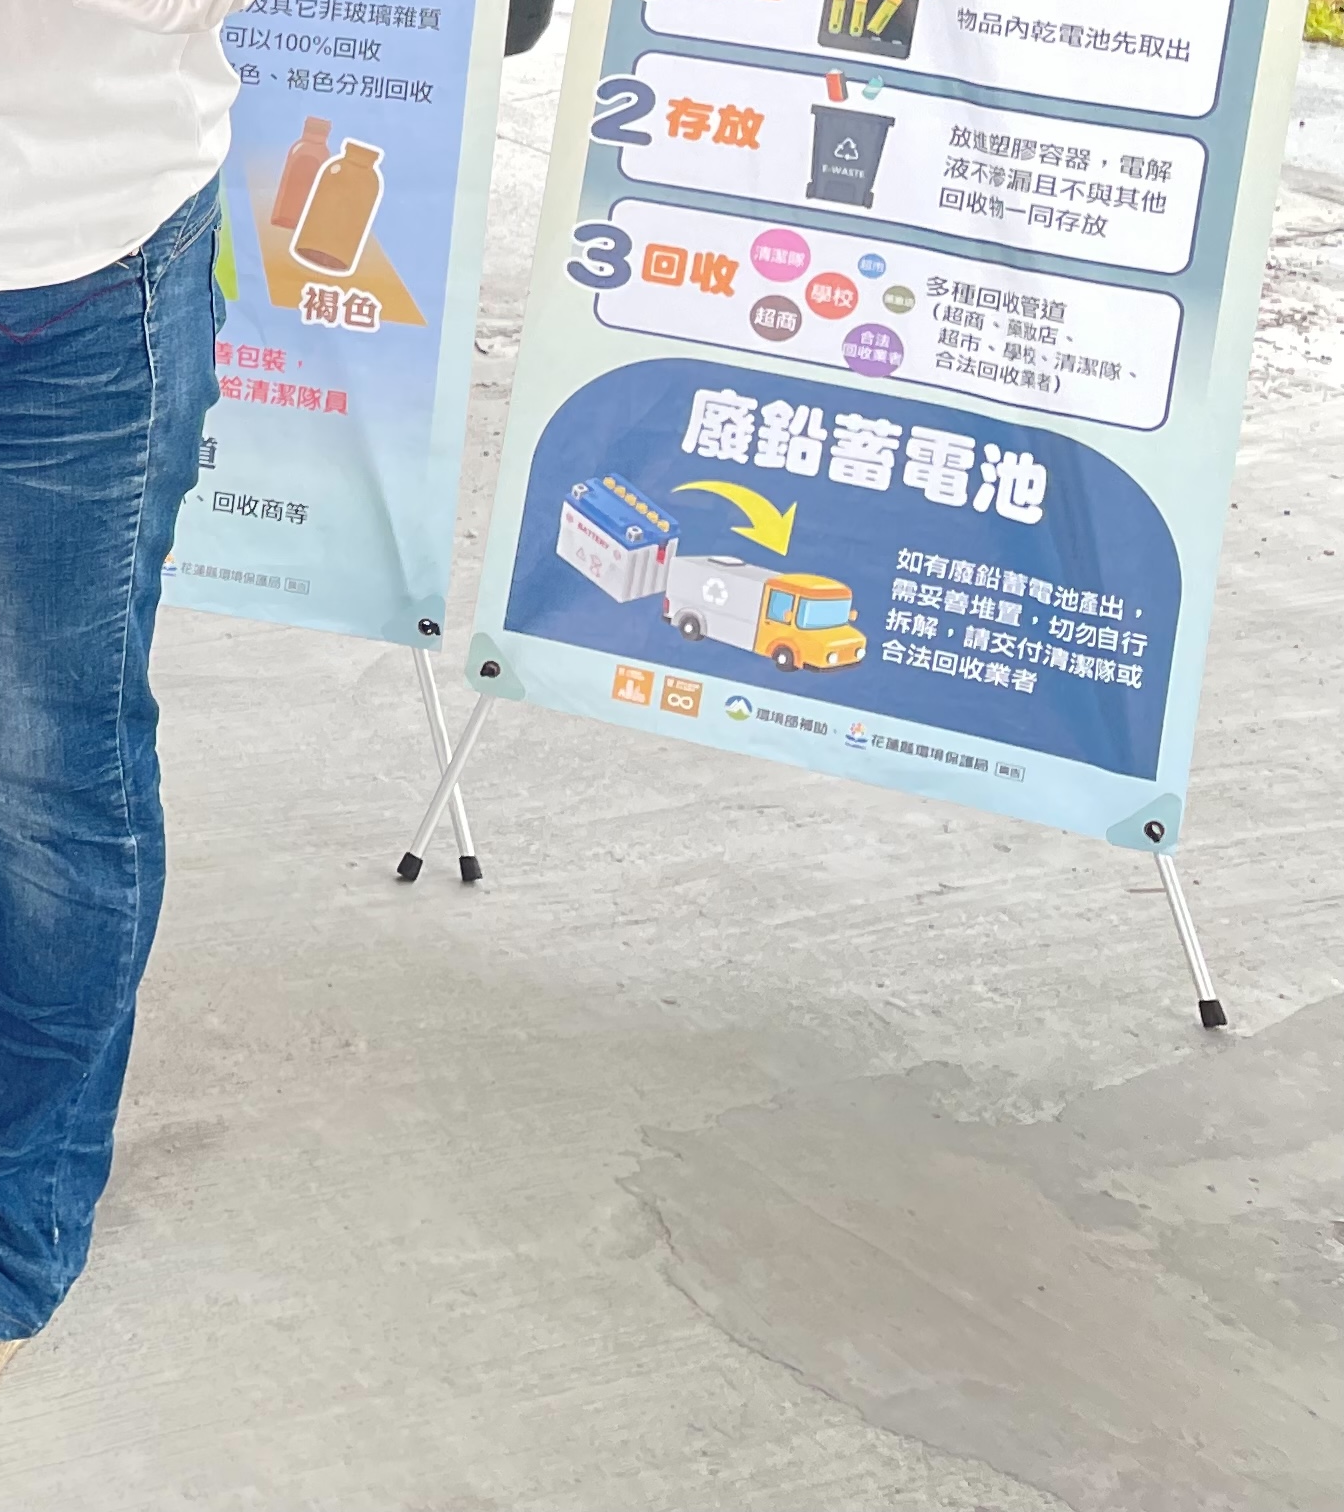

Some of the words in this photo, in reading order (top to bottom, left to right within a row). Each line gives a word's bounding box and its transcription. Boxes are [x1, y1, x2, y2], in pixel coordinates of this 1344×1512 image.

[957, 8, 1191, 62] 物品內乾電池先取出
[229, 63, 433, 104] 色、褐色分別回收
[597, 80, 655, 145] 2
[666, 98, 764, 150] 存放
[938, 191, 1107, 238] 回收物一同存放
[569, 223, 631, 287] 3
[642, 244, 739, 297] 回收
[304, 288, 379, 329] 褐色
[754, 308, 798, 332] 超商
[812, 285, 854, 308] 學校
[926, 276, 1067, 322] 多種回收管道
[681, 388, 1048, 526] 廢鉛蓄電池
[881, 640, 1037, 694] 合法回收業者
